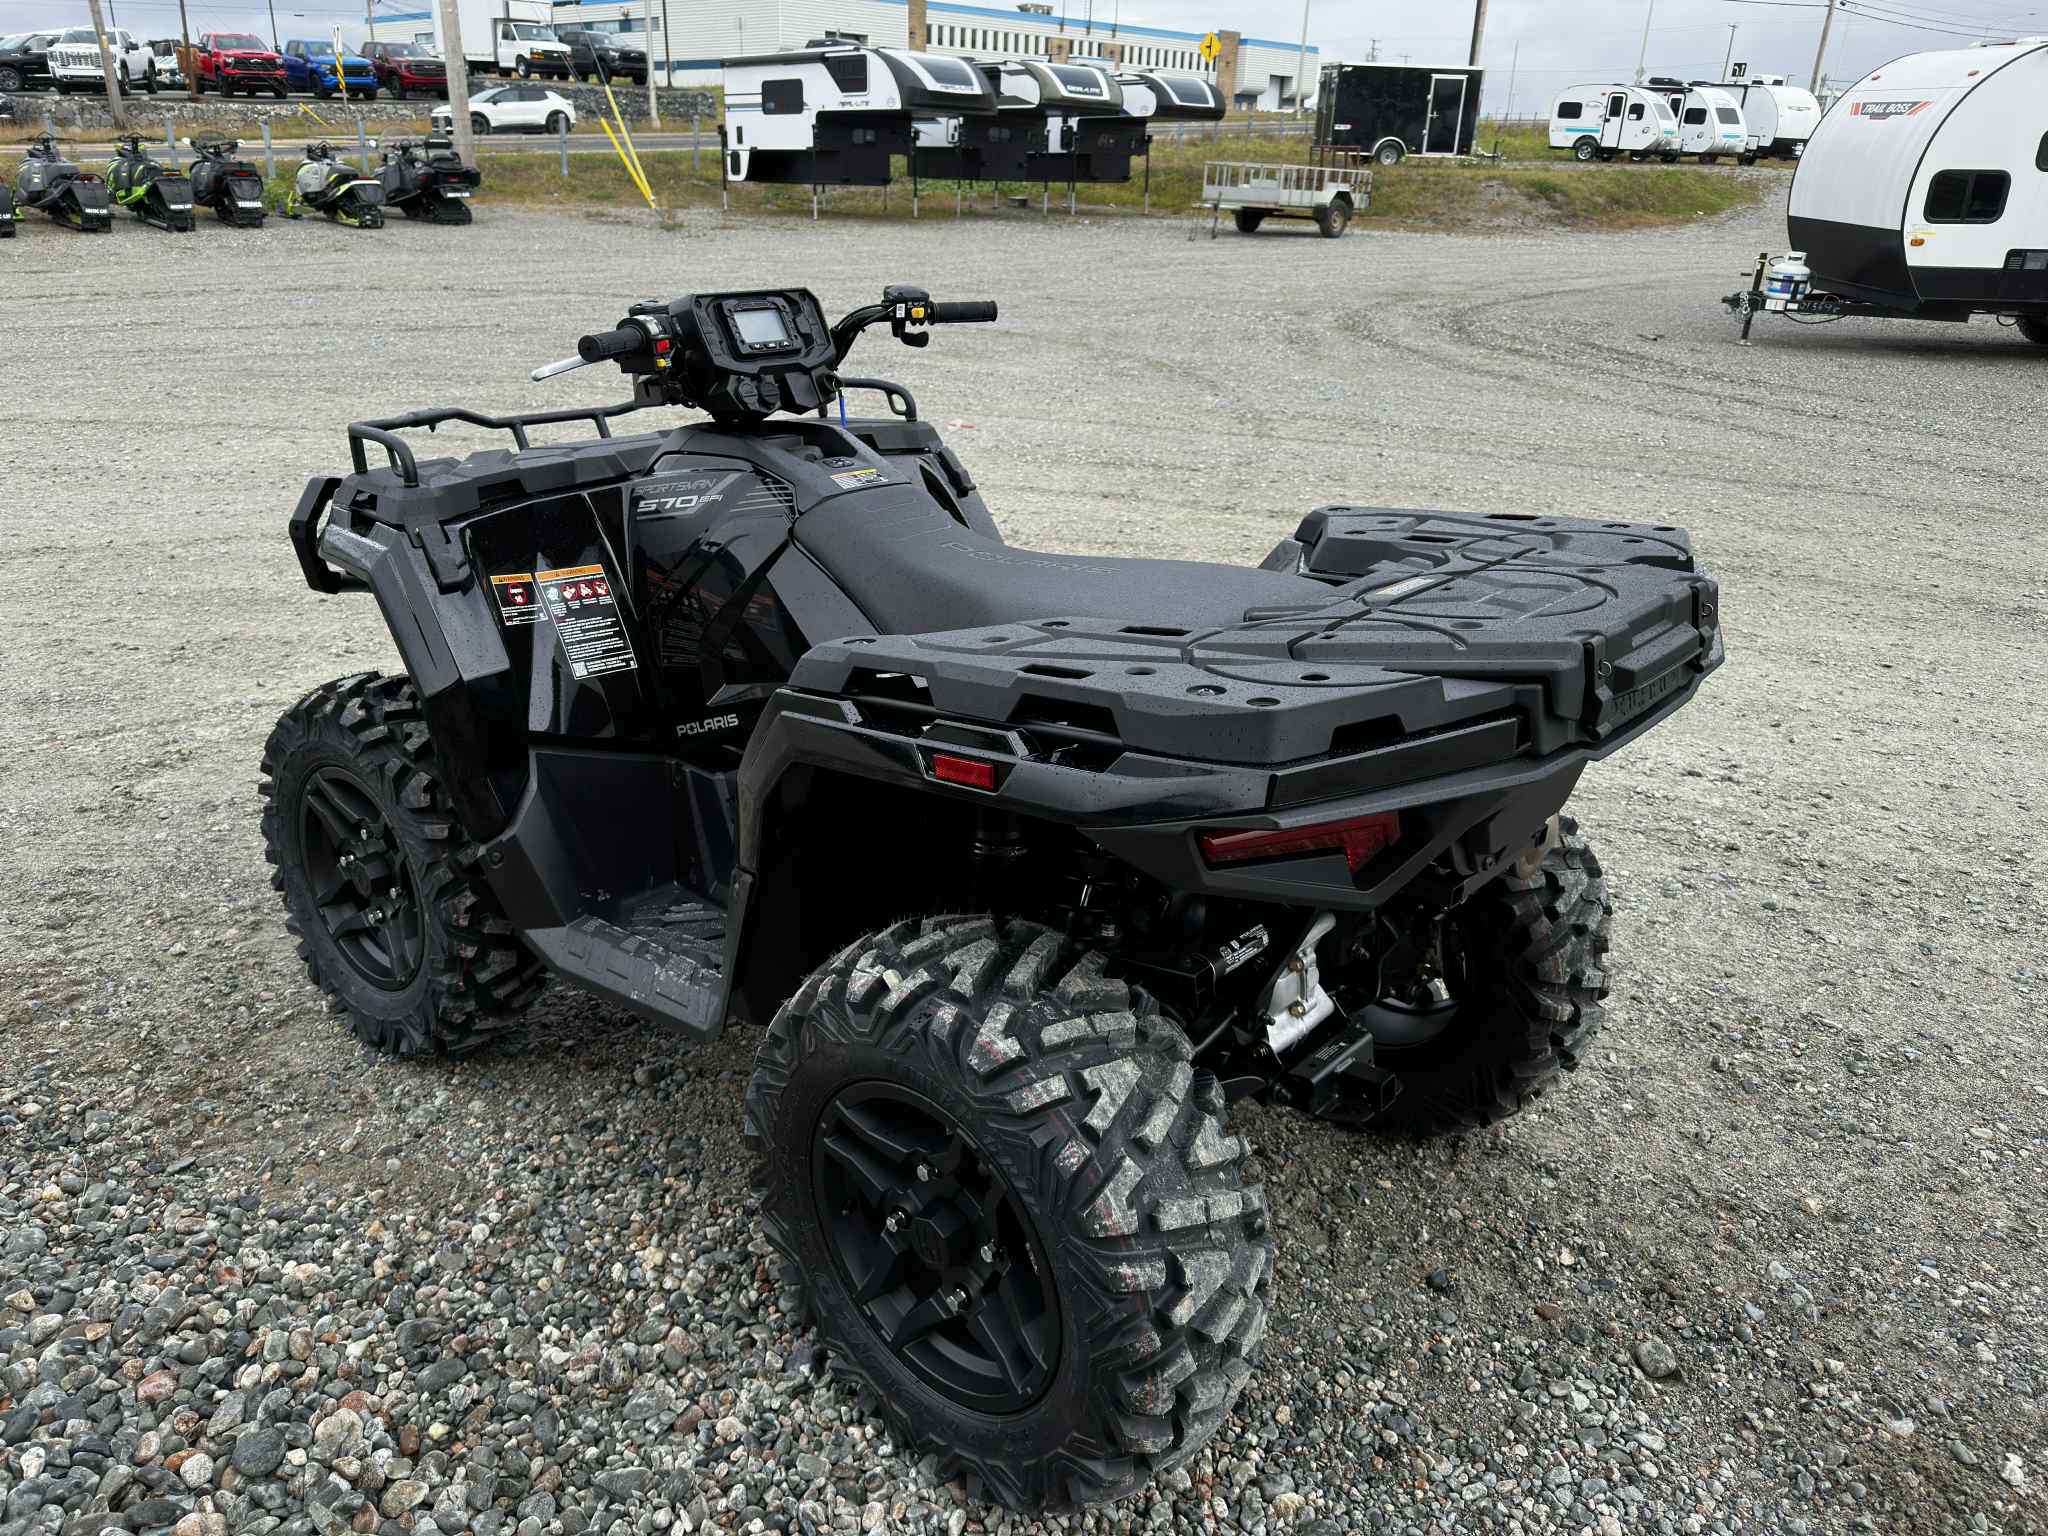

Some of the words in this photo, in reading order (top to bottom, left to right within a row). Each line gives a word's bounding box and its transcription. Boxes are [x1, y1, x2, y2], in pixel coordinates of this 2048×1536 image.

[1862, 103, 1886, 113] TRAIL
[1886, 103, 1913, 113] BOSS
[637, 495, 700, 513] 570
[699, 494, 724, 504] EFI
[676, 713, 739, 737] POLARIS
